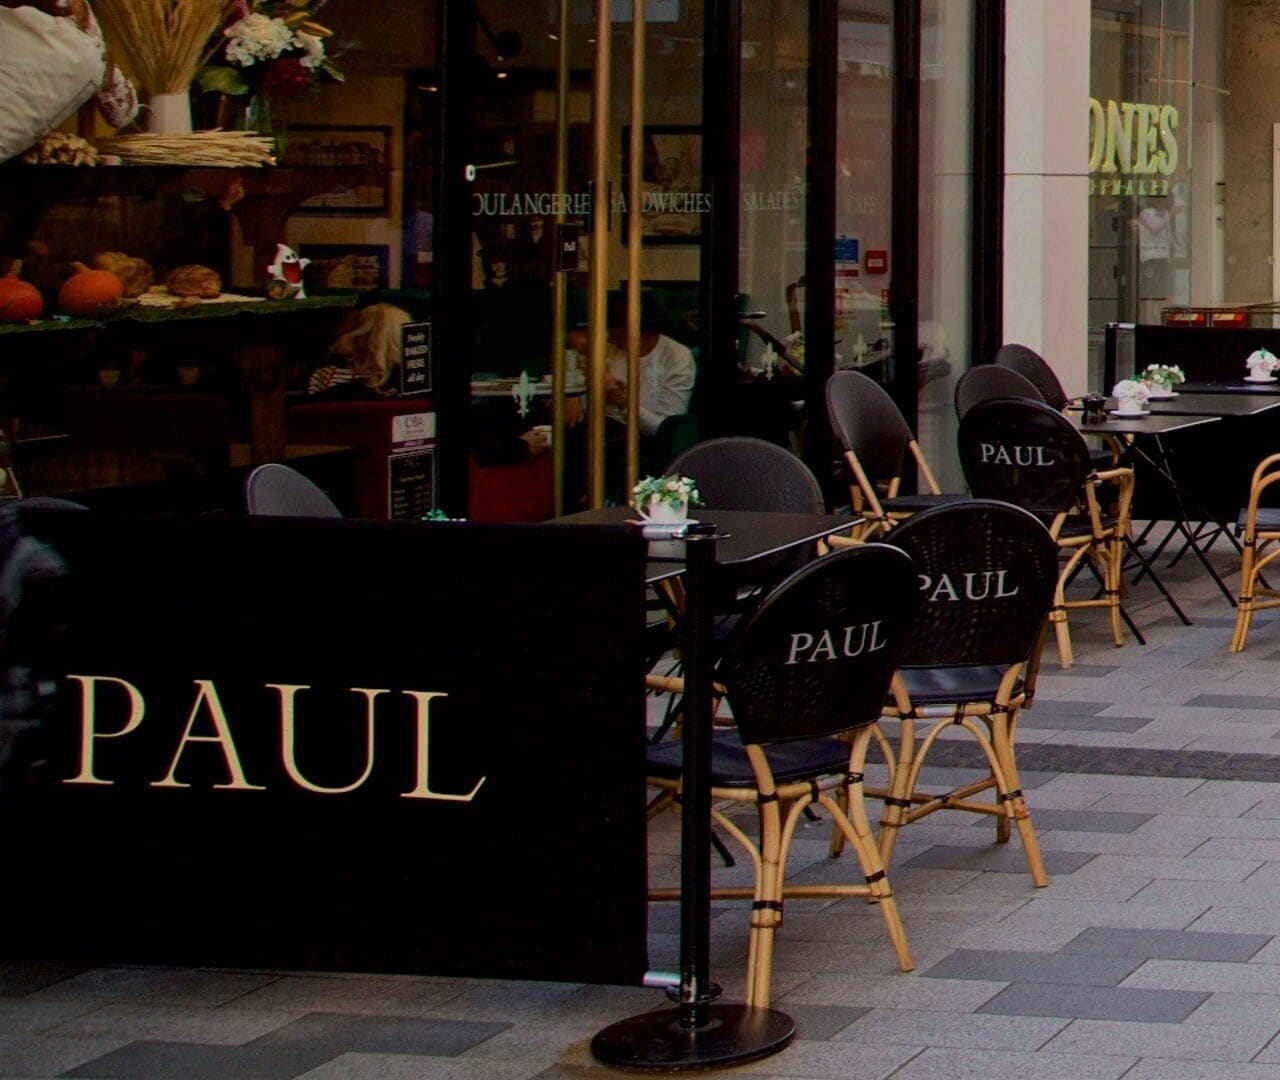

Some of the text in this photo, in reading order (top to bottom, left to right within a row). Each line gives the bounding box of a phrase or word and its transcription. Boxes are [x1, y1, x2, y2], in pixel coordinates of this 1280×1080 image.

[610, 191, 712, 215] SADWICHES
[981, 443, 1055, 466] PAUL
[785, 620, 887, 665] PAUL
[62, 674, 486, 803] PAUL
